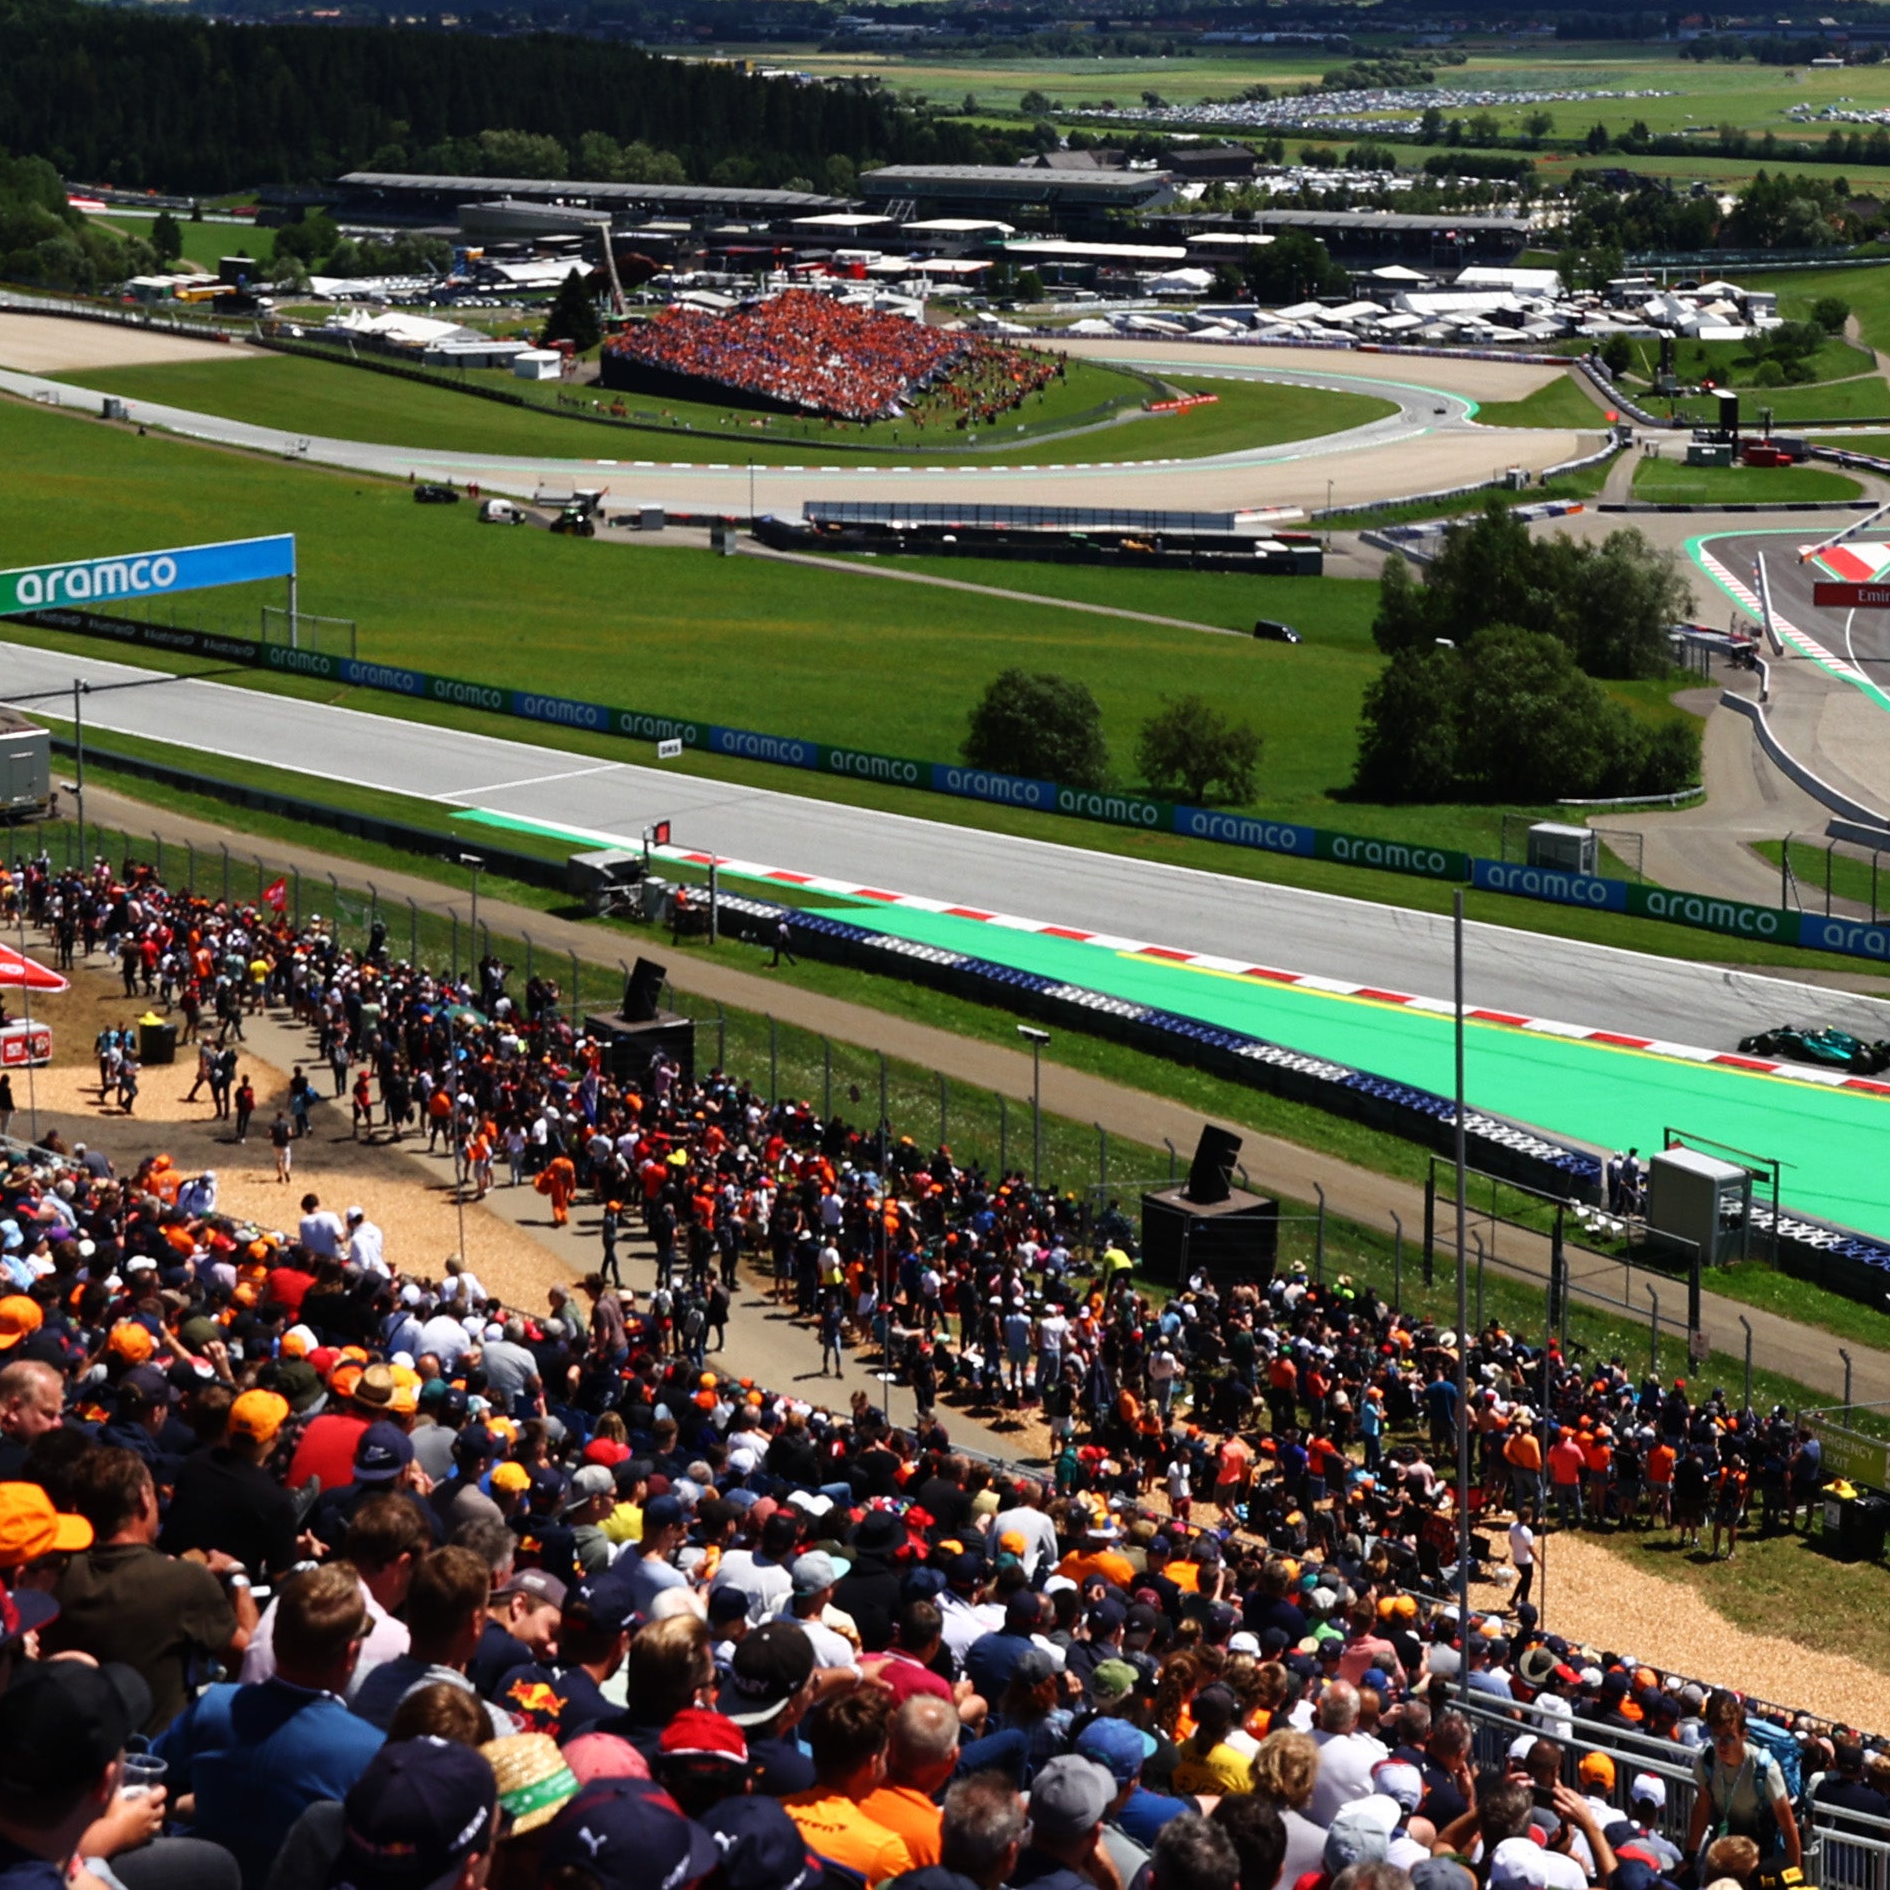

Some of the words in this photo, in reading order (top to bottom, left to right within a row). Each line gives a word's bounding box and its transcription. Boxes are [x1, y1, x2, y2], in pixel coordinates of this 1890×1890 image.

[16, 557, 177, 605] aramco
[270, 647, 331, 674] aramco
[349, 662, 414, 690] aramco
[435, 679, 502, 709] aramco
[524, 695, 597, 725] aramco
[621, 713, 697, 743] aramco
[722, 730, 804, 762] aramco
[830, 750, 917, 783] aramco
[947, 769, 1040, 803] aramco
[1059, 789, 1158, 825] aramco
[1191, 812, 1297, 849] aramco
[1332, 836, 1446, 873] aramco
[1486, 865, 1607, 903] aramco
[1647, 891, 1778, 935] aramco
[1805, 1424, 1874, 1461] MERGENCY
[1824, 1451, 1850, 1471] EXIT
